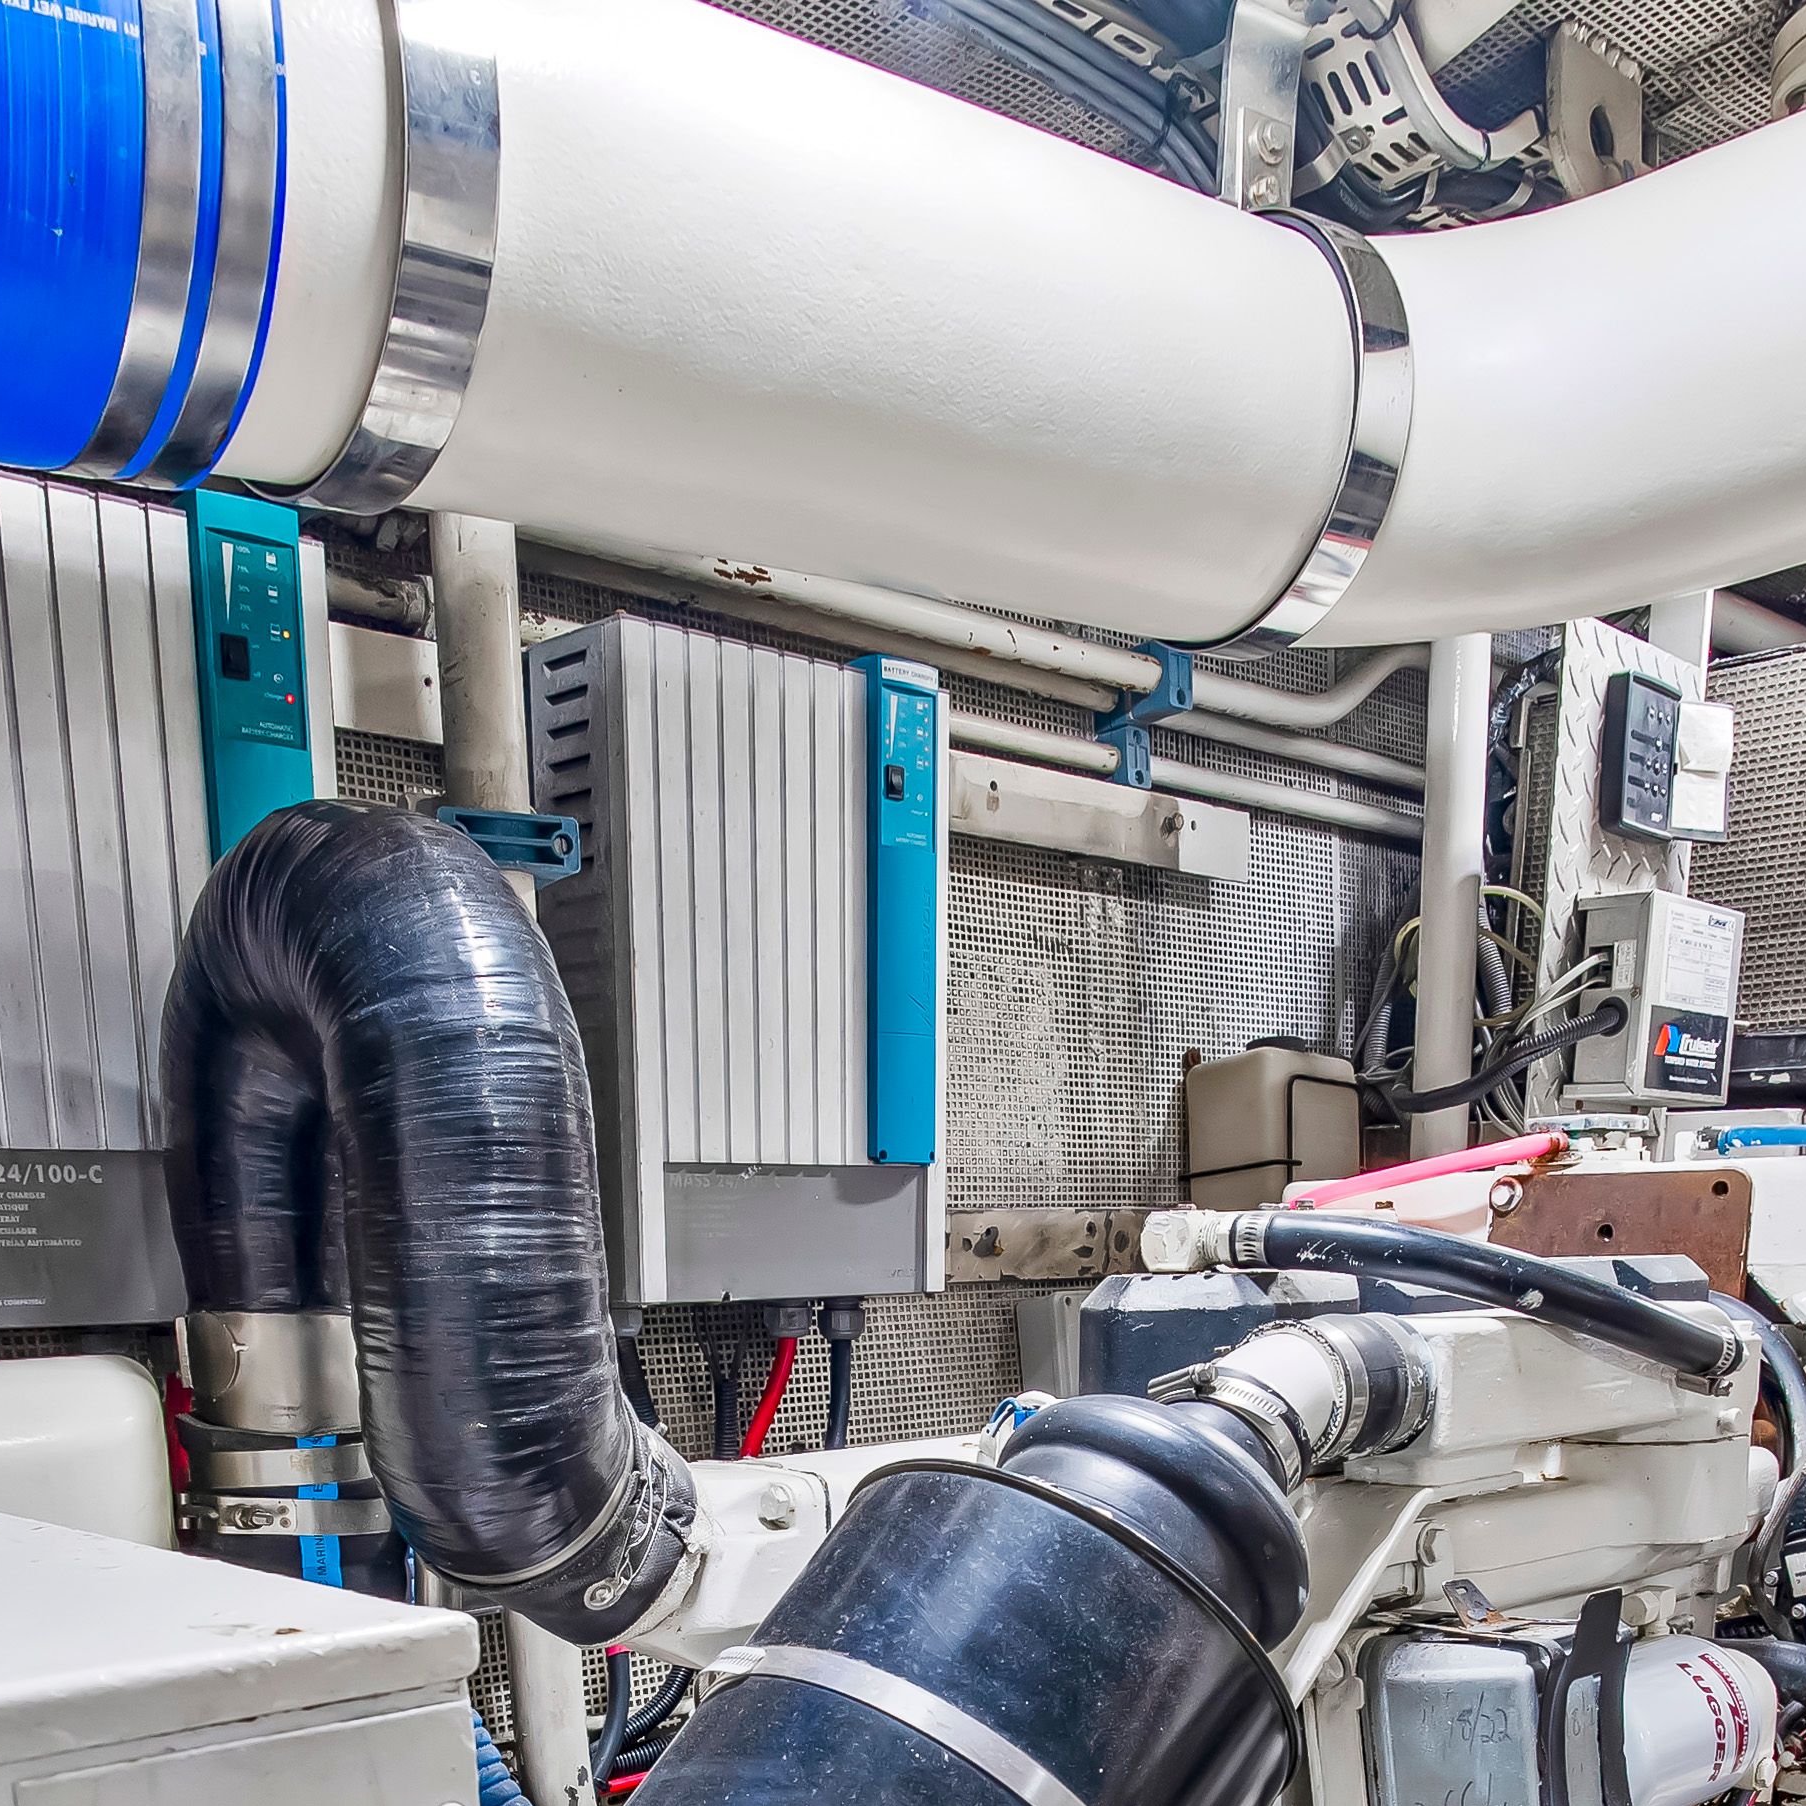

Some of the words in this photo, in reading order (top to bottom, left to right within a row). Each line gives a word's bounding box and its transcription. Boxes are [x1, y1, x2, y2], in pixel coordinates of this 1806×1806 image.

[32, 3, 63, 21] WET
[65, 12, 117, 32] MARINE
[6, 1191, 46, 1200] CHARGER
[315, 1535, 327, 1576] MARIN
[1676, 1662, 1726, 1783] LUGGER
